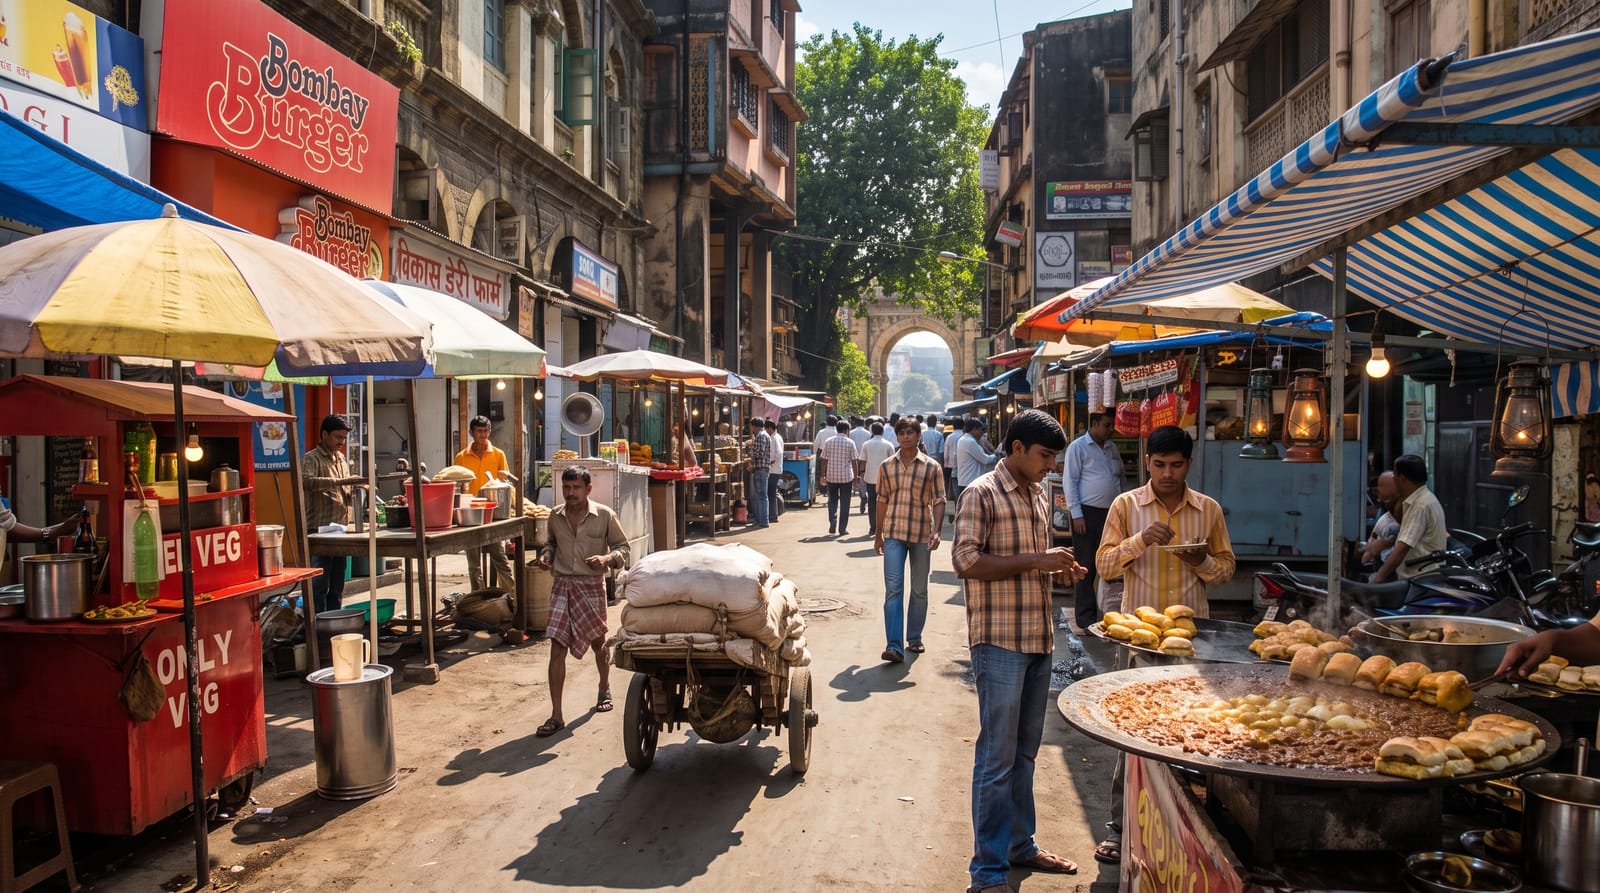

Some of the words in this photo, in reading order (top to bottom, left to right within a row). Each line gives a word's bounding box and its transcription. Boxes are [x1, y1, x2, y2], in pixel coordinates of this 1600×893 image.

[207, 42, 369, 173] Burger
[261, 32, 369, 130] Bombay
[293, 215, 369, 279] Burger
[314, 203, 370, 253] Bombay
[397, 238, 441, 290] विकास
[445, 256, 469, 298] डेरी
[472, 273, 502, 307] फार्म
[196, 530, 241, 568] VEG
[168, 682, 219, 728] VG
